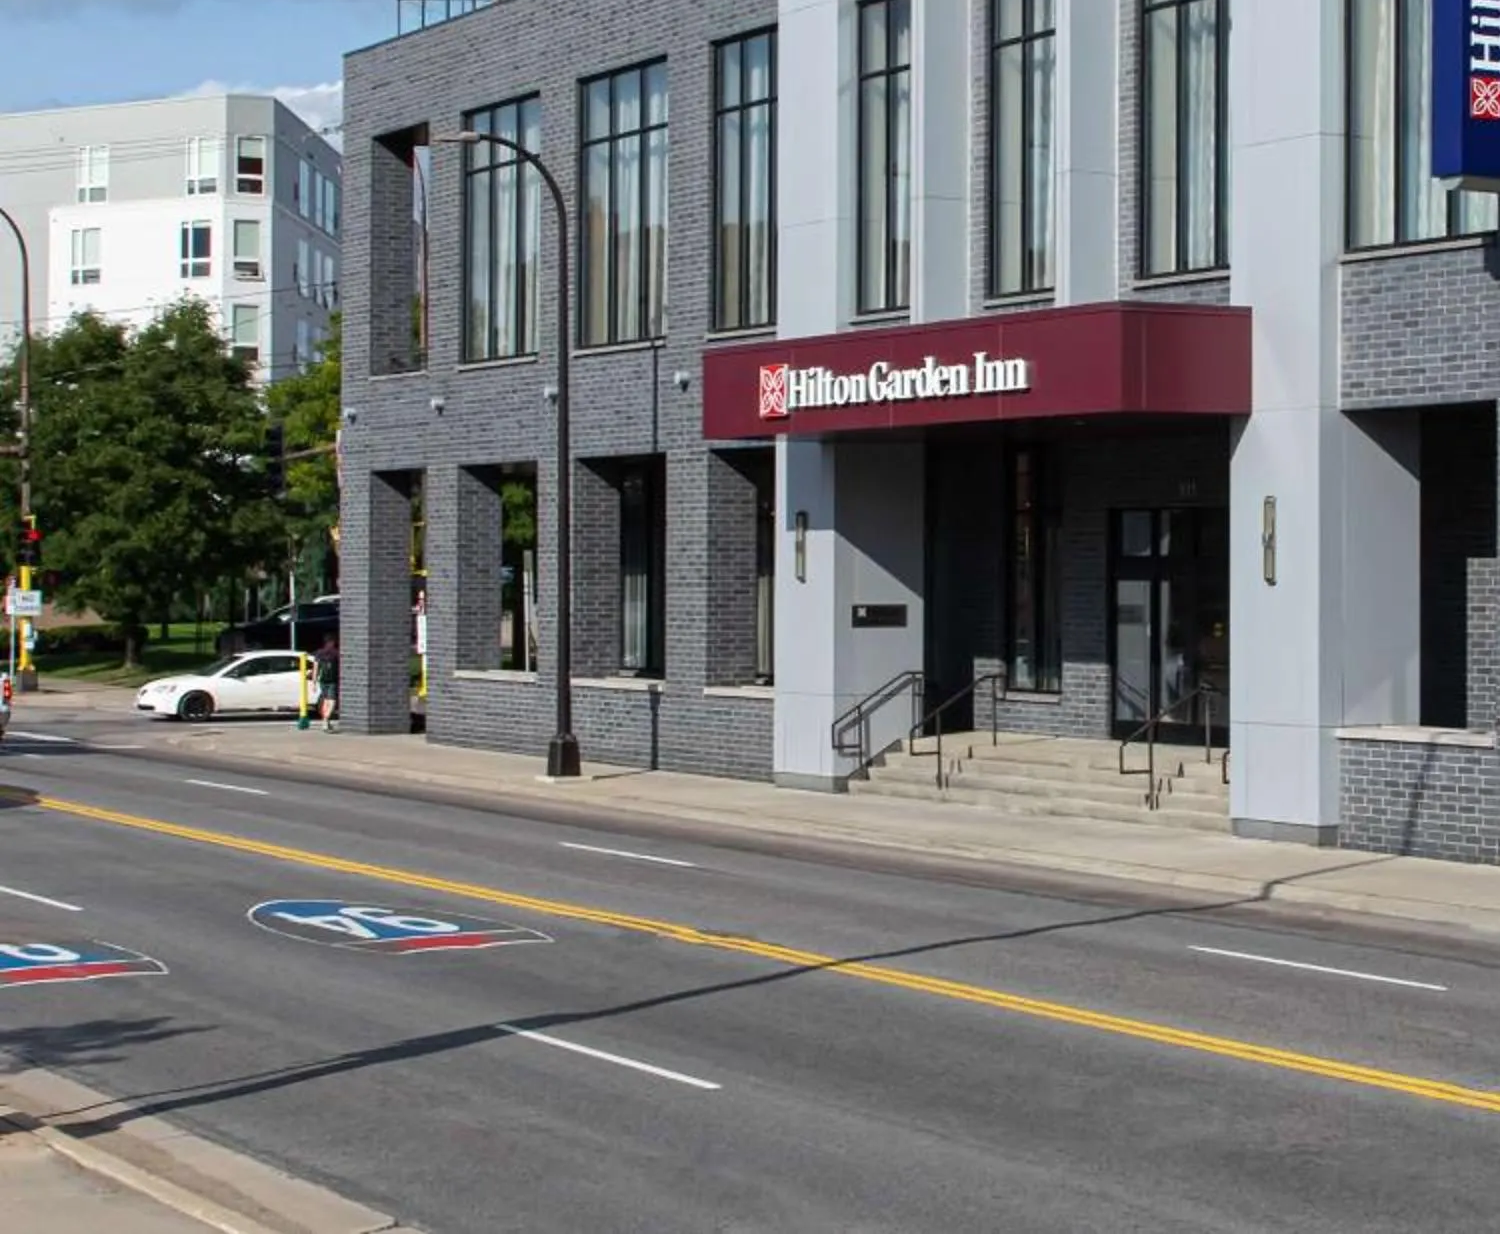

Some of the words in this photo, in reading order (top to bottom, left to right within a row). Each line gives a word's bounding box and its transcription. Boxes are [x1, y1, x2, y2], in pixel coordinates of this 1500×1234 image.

[788, 364, 868, 408] Hilton
[869, 355, 969, 402] Garden
[973, 351, 1027, 392] Inn
[273, 907, 459, 939] 94
